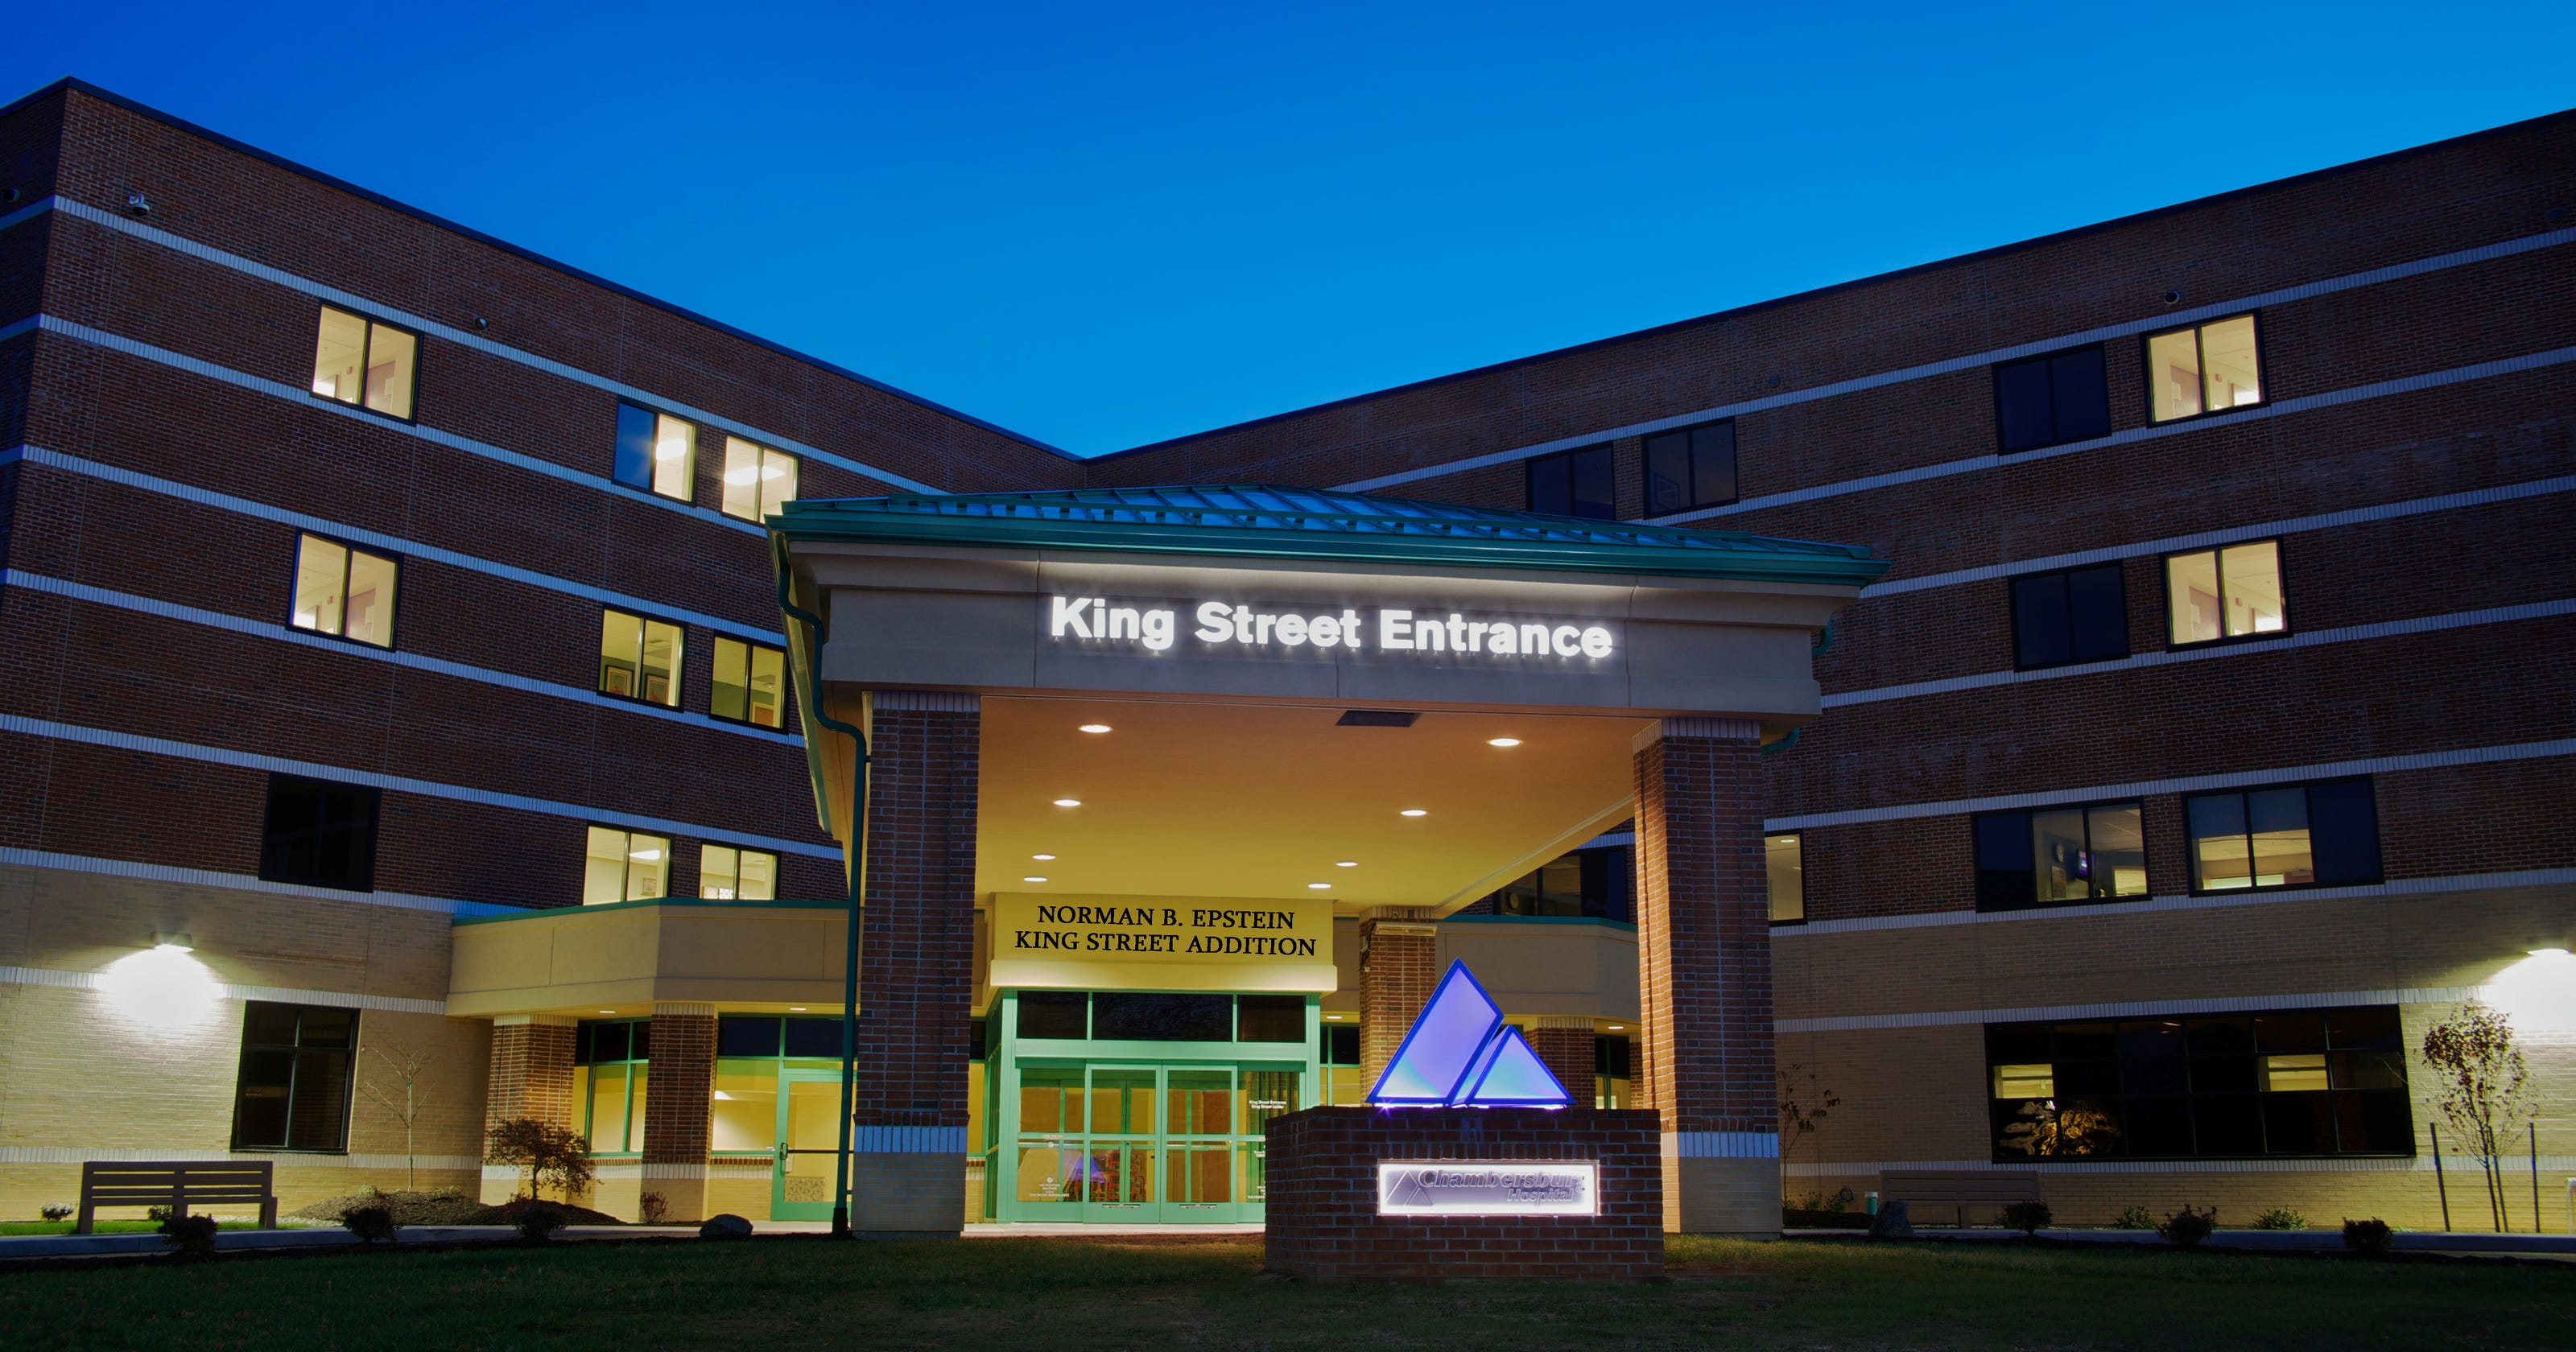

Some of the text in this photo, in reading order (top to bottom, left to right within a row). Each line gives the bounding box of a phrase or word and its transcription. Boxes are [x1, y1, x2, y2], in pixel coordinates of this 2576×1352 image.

[1051, 596, 1612, 659] King Street Entrance
[1037, 905, 1295, 930] NORMAN B. EPSTEIN
[1014, 930, 1317, 957] KING STREET ADDITION
[1418, 1169, 1586, 1193] Chambersburg
[1506, 1188, 1575, 1206] Hospital
